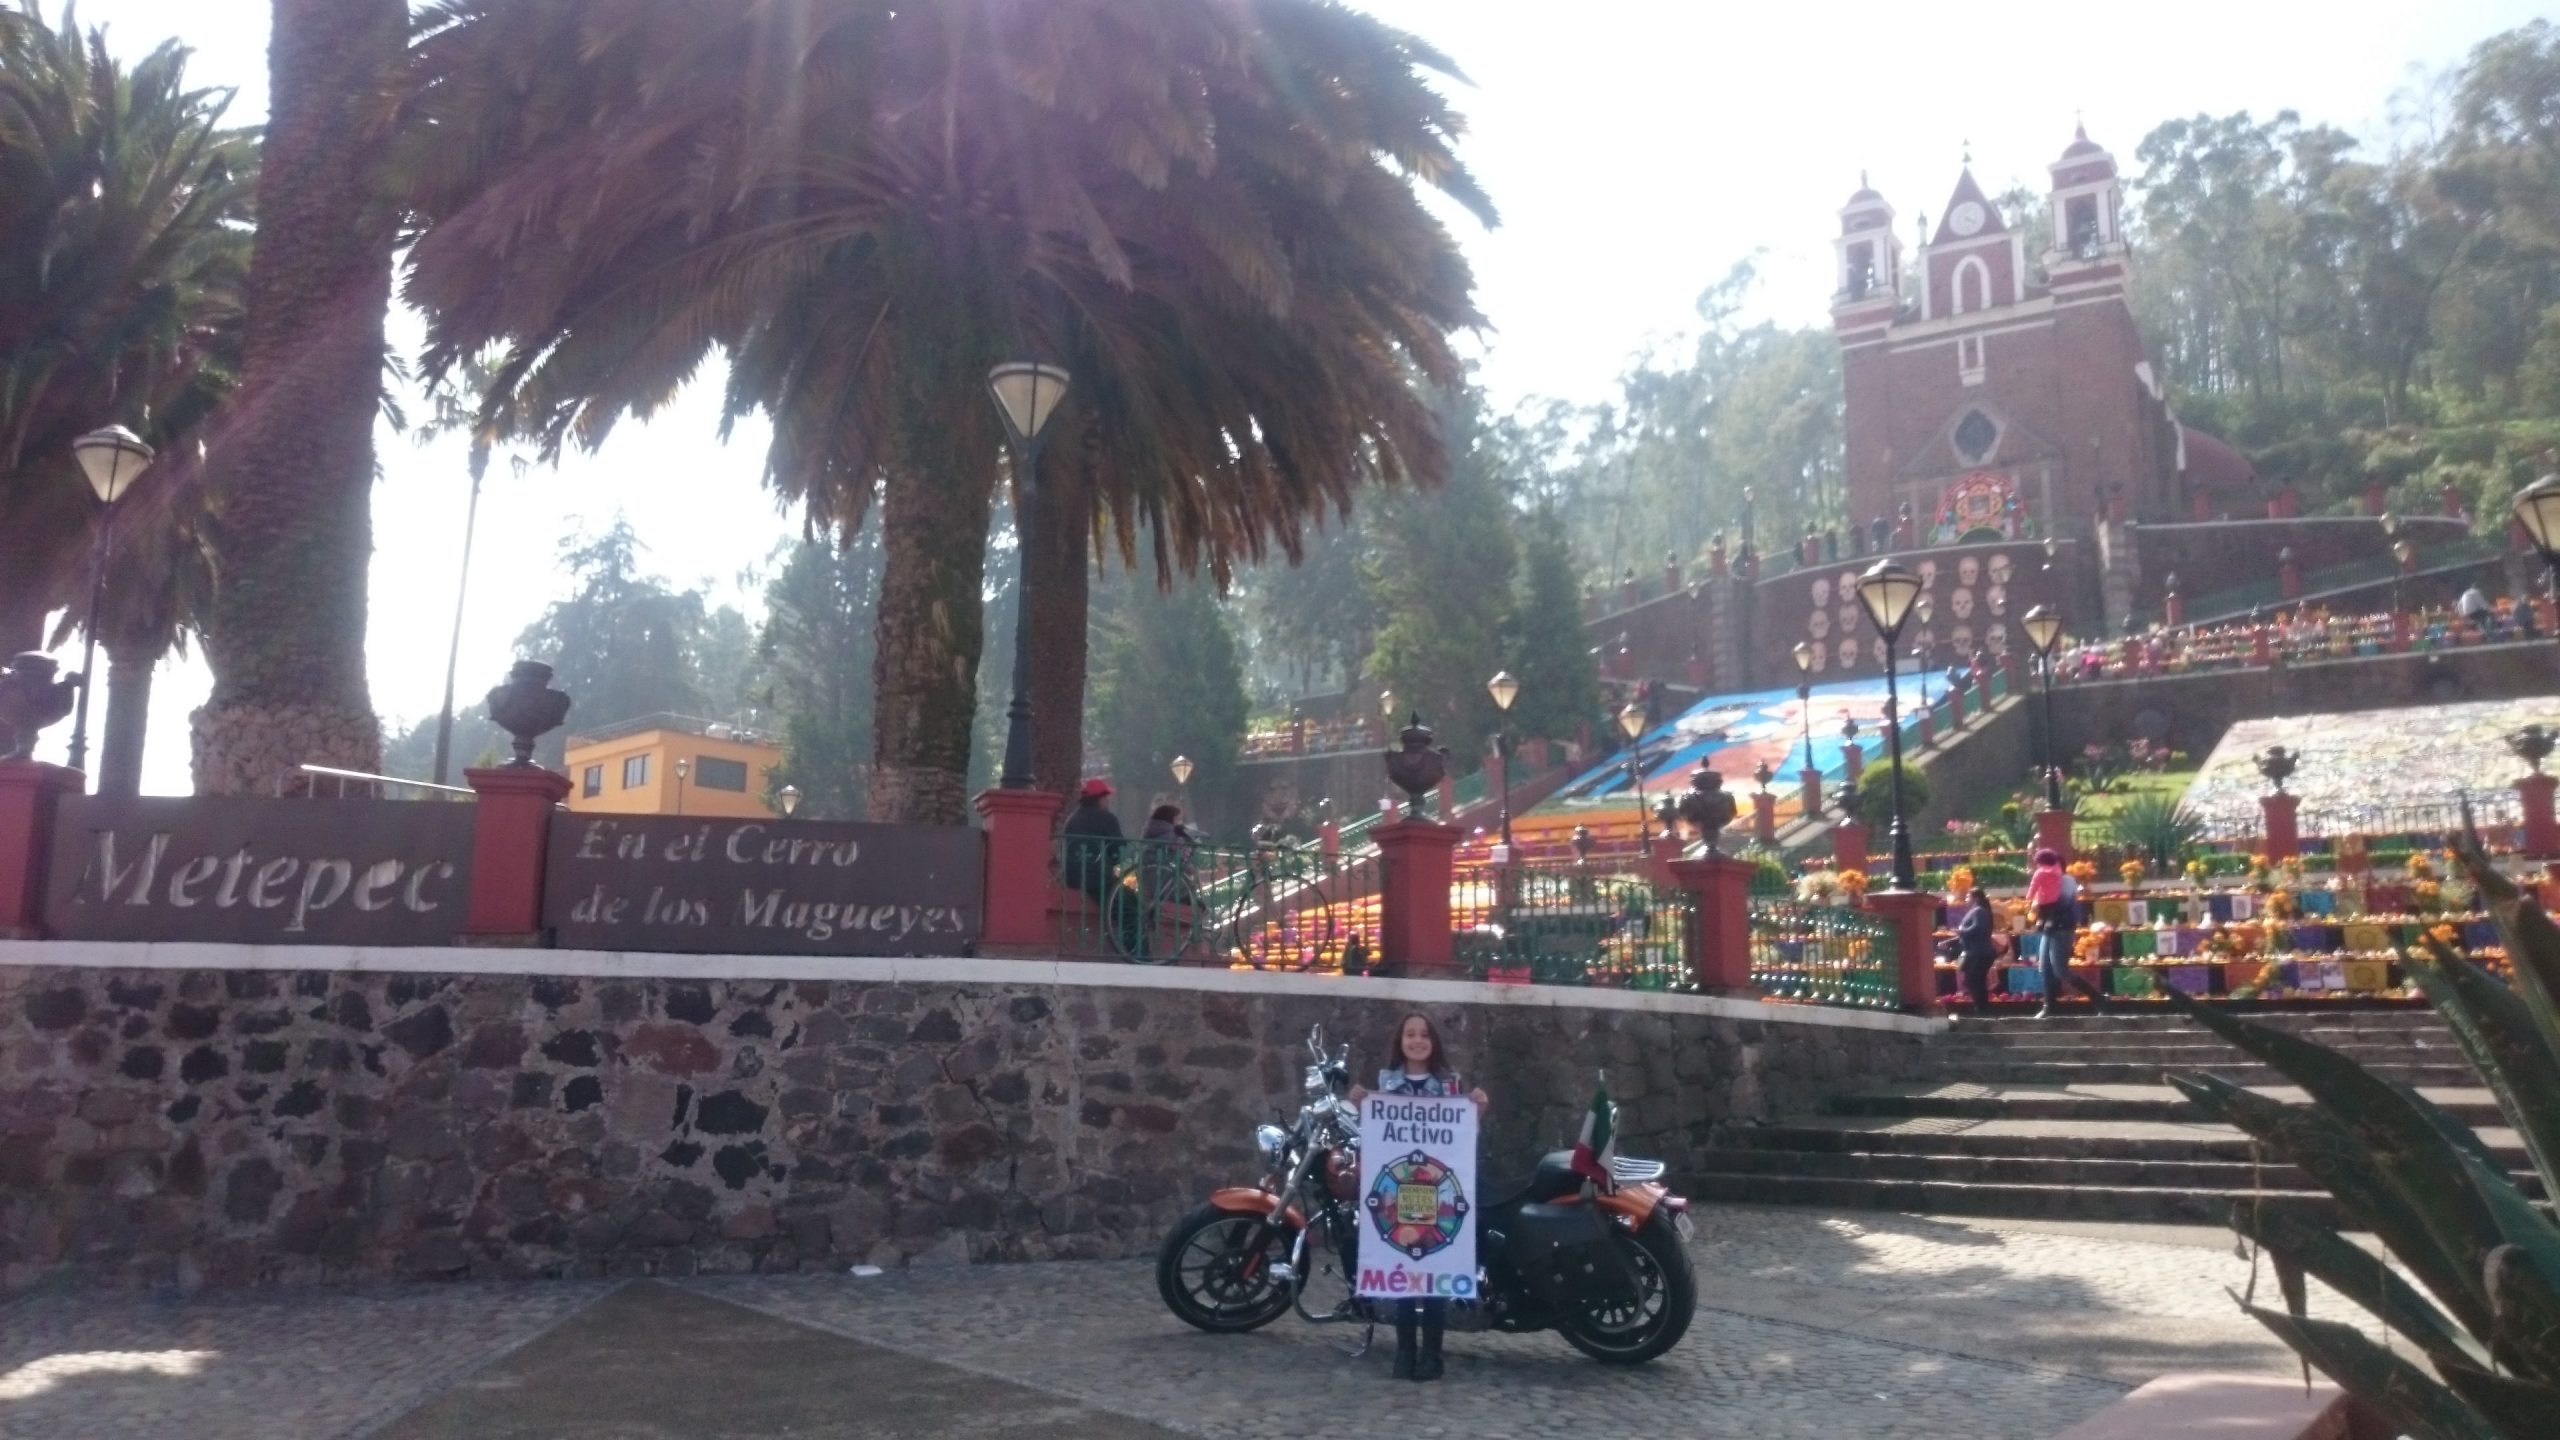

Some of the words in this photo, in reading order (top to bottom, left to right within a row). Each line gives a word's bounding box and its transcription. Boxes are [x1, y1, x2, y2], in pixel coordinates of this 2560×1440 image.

[576, 819, 647, 861] En
[663, 826, 706, 863] el
[725, 823, 861, 868] Cerro
[76, 829, 454, 932] Metepec
[571, 883, 629, 925] de
[643, 885, 711, 927] los
[732, 888, 965, 942] Magueyes
[1371, 1099, 1467, 1124] Rodador
[1382, 1121, 1454, 1146] Activo
[1412, 1153, 1424, 1163] N
[1456, 1201, 1466, 1212] E
[1411, 1247, 1422, 1257] S
